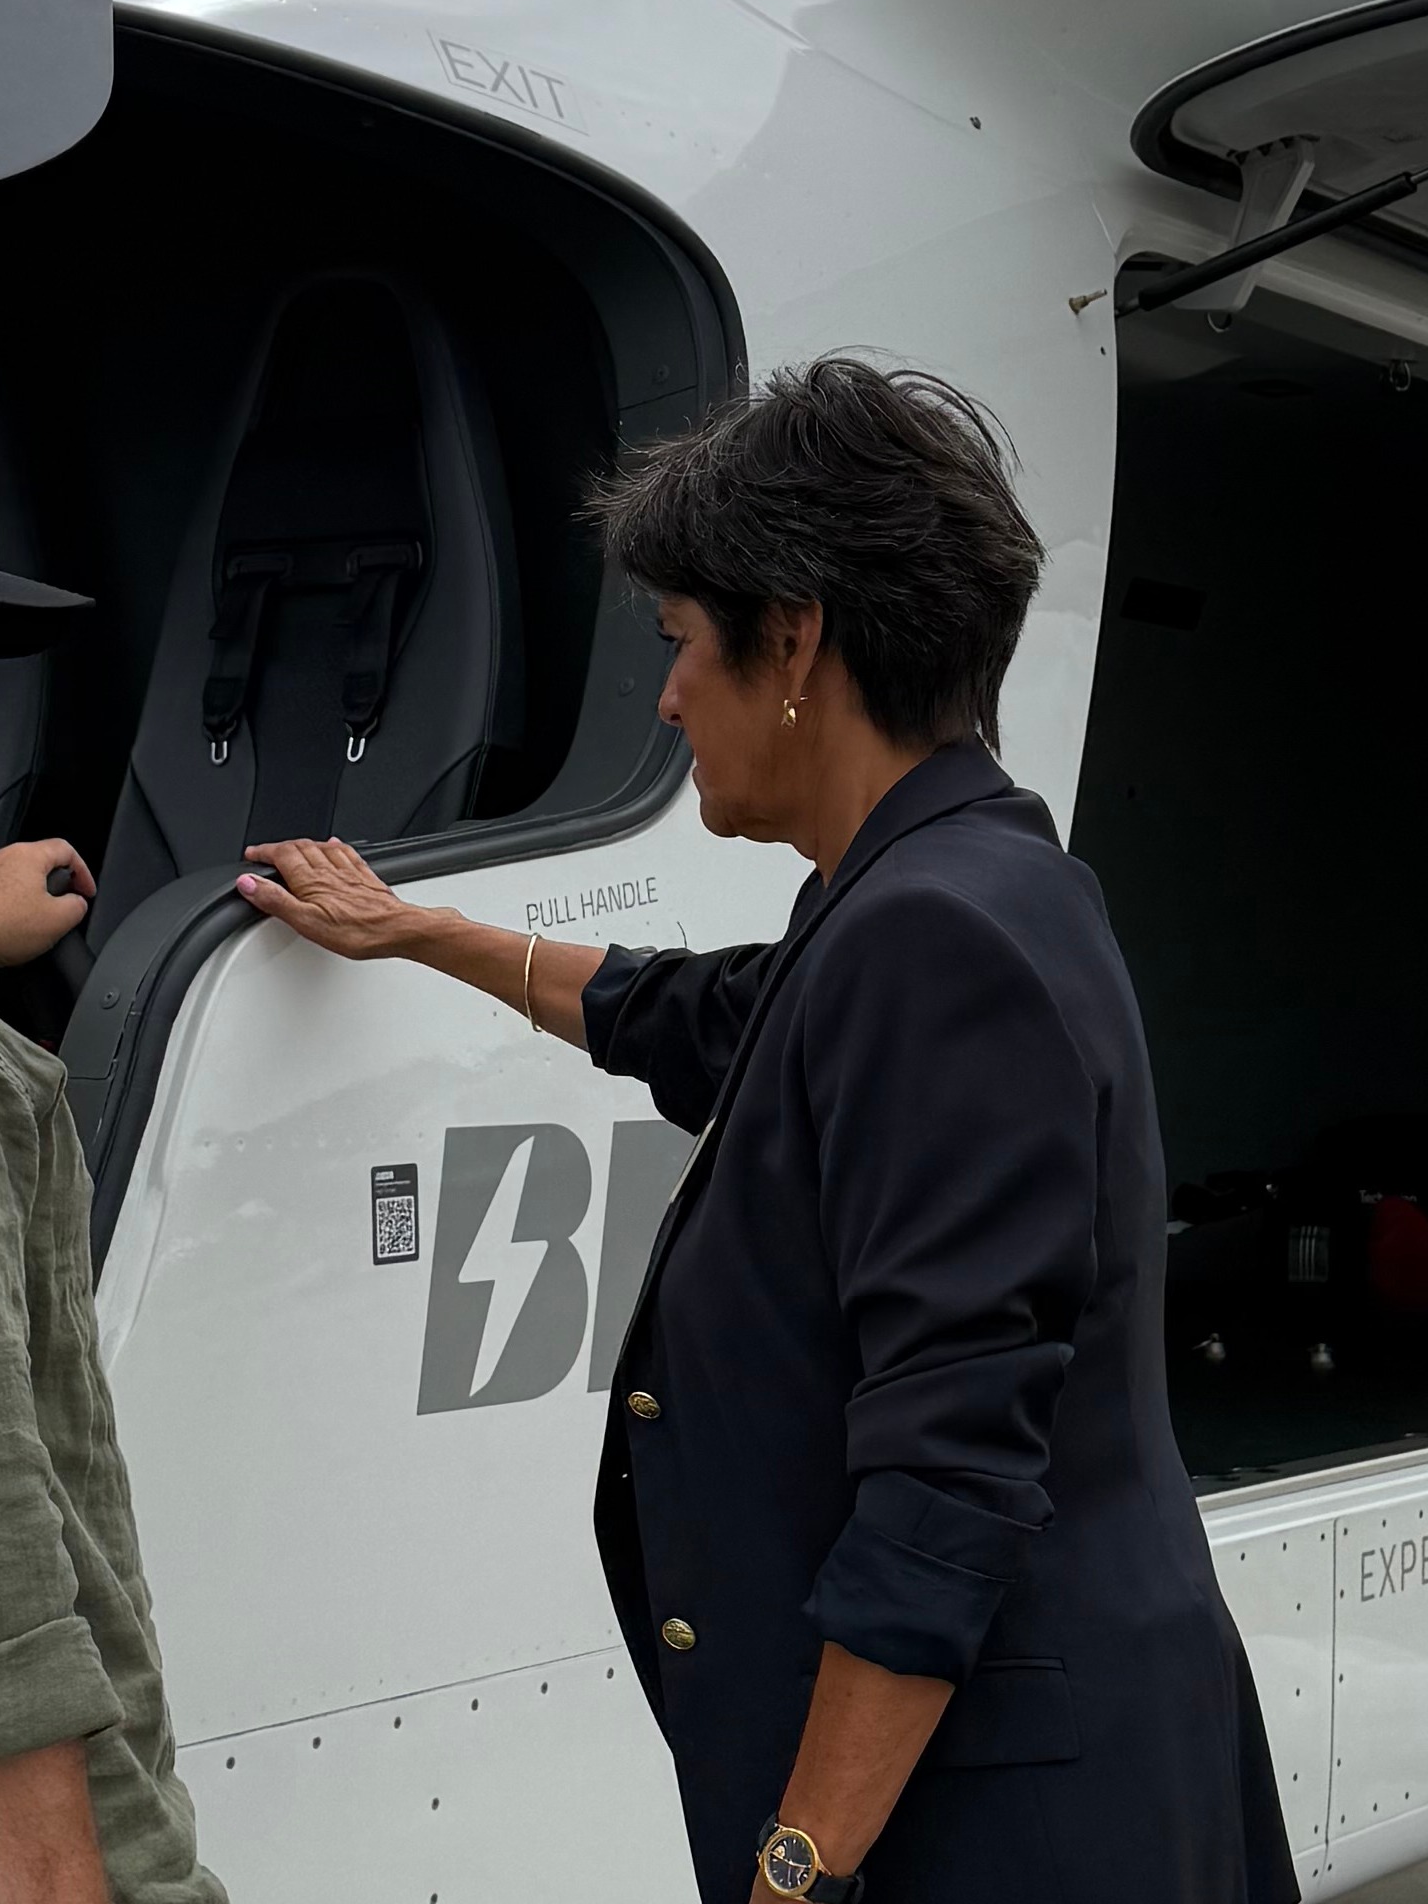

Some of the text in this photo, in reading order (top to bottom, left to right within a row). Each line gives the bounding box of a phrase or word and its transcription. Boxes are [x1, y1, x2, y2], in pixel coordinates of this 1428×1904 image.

[439, 39, 565, 119] EXIT
[526, 877, 659, 930] PULL HANDLE
